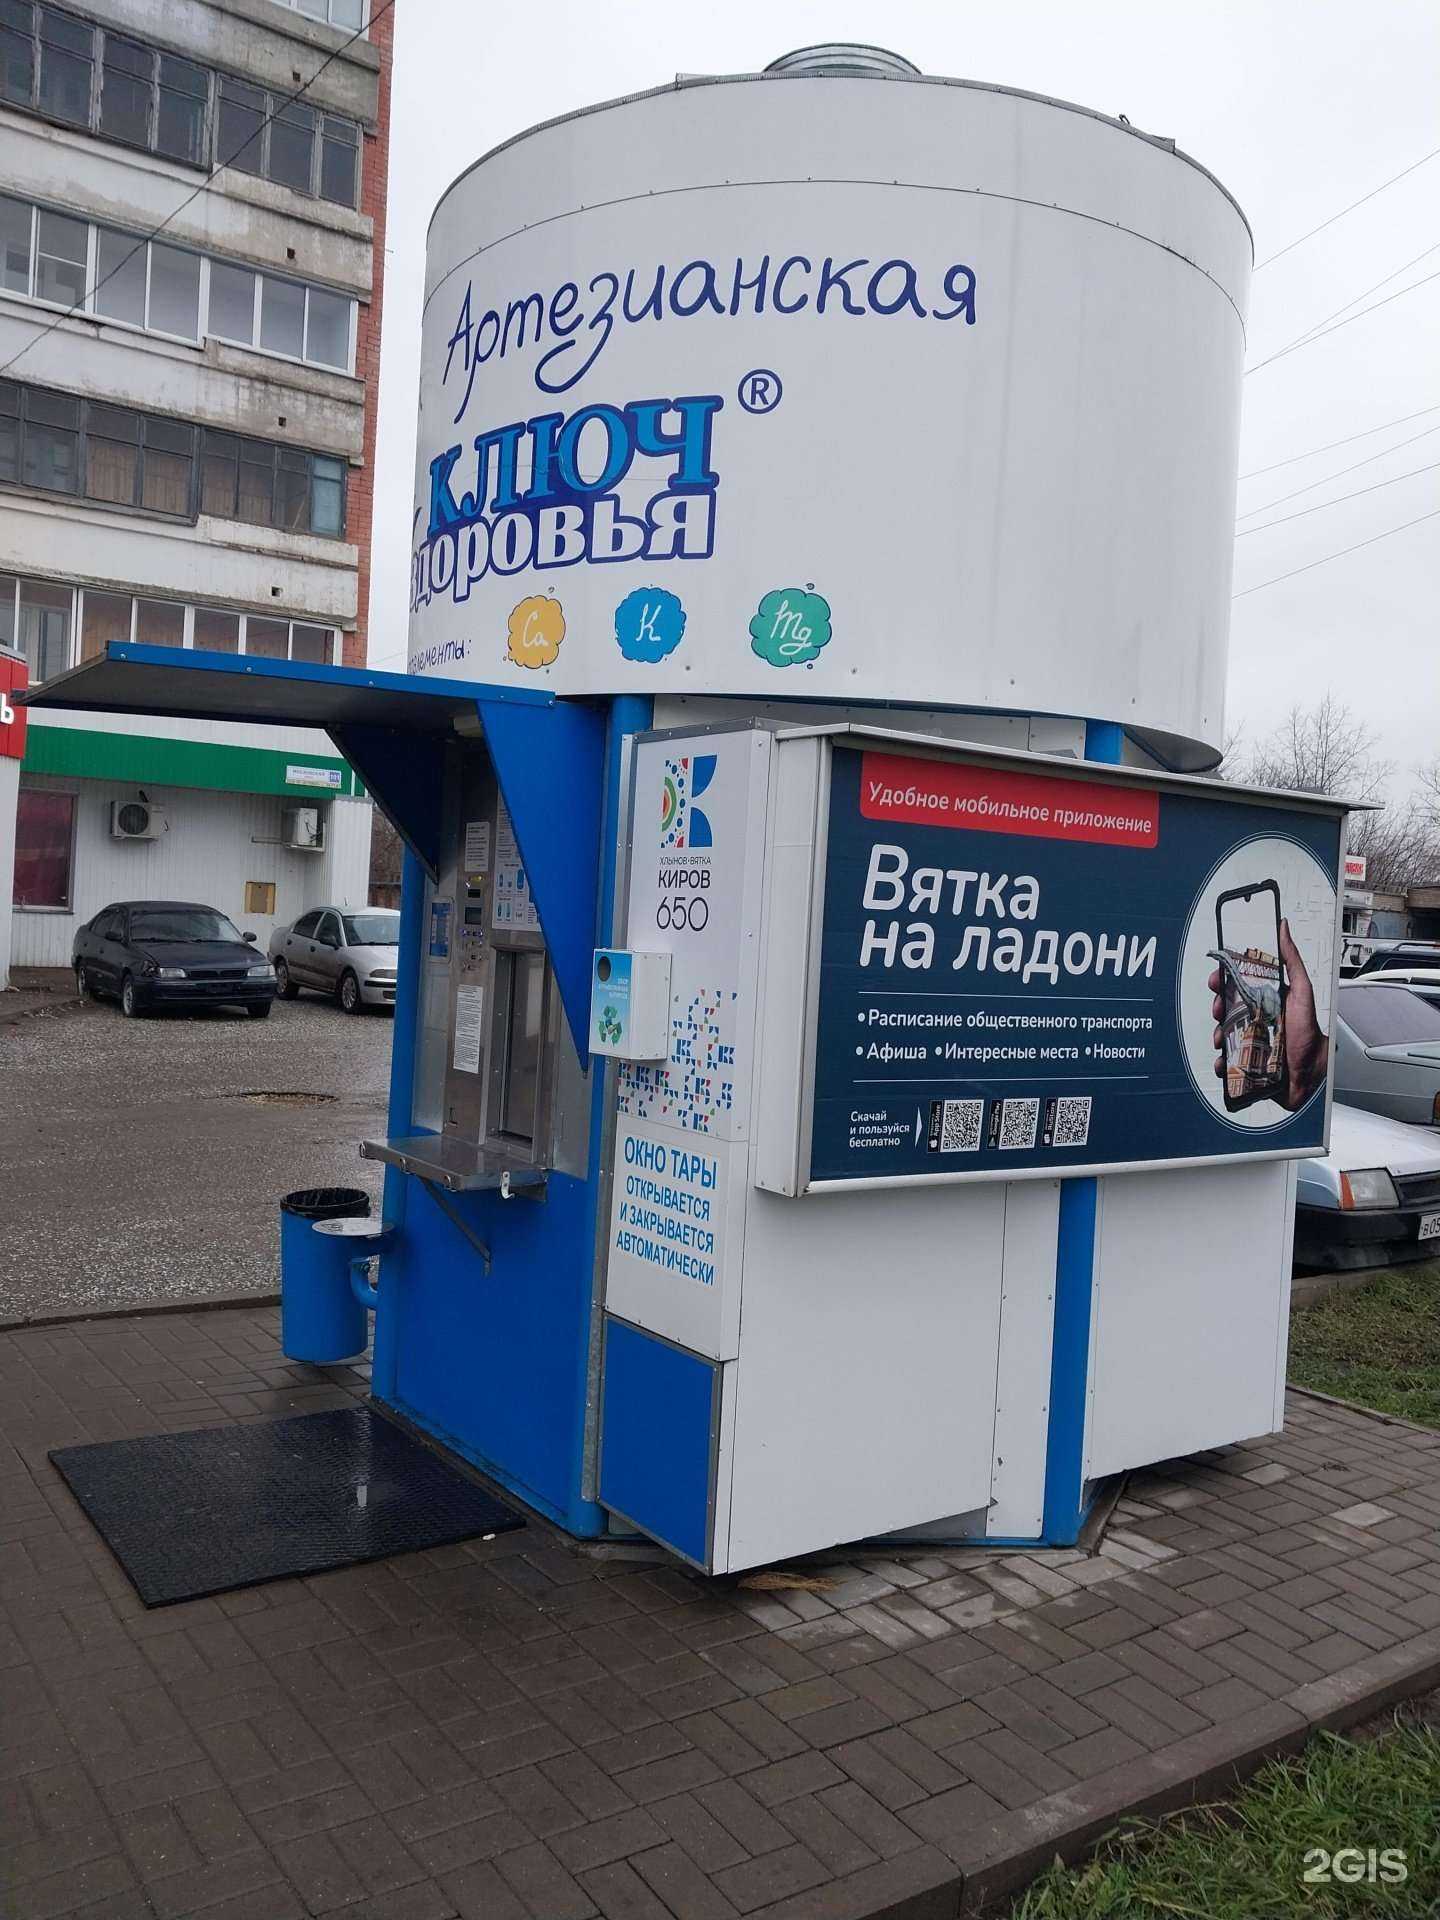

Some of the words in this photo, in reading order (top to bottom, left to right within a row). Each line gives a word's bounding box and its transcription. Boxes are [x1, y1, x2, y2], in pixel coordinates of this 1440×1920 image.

[442, 253, 978, 425] Артезианская
[428, 394, 725, 534] КЛЮЧ
[522, 610, 549, 647] Ca
[769, 600, 813, 656] Mg
[869, 781, 950, 811] Удобное
[953, 796, 1050, 822] мобильное
[1053, 809, 1152, 835] приложение
[658, 868, 711, 889] КИРОВ
[863, 843, 1040, 921] Вятка
[656, 896, 709, 932] 650
[859, 919, 936, 970] на
[952, 926, 1157, 986] ладони
[868, 1008, 963, 1028] Расписание
[966, 1011, 1078, 1031] общественного
[1080, 1014, 1153, 1033] транспорта
[866, 1042, 927, 1064] Афиша
[944, 1042, 1035, 1063] Интересные
[1039, 1047, 1079, 1060] места
[1093, 1043, 1146, 1060] Новости
[850, 1110, 888, 1123] Скачай
[850, 1126, 857, 1135] и
[858, 1122, 910, 1137] пользуйся
[624, 1136, 667, 1174] ОКНО
[671, 1149, 717, 1190] ТАРЫ
[849, 1136, 901, 1149] бесплатно
[626, 1175, 711, 1222] ОТКРЫВАЕТСЯ
[619, 1201, 628, 1222] И
[629, 1204, 715, 1255] ЗАКРЫВАЕТСЯ
[615, 1229, 715, 1286] АВТОМАТИЧЕСКИ
